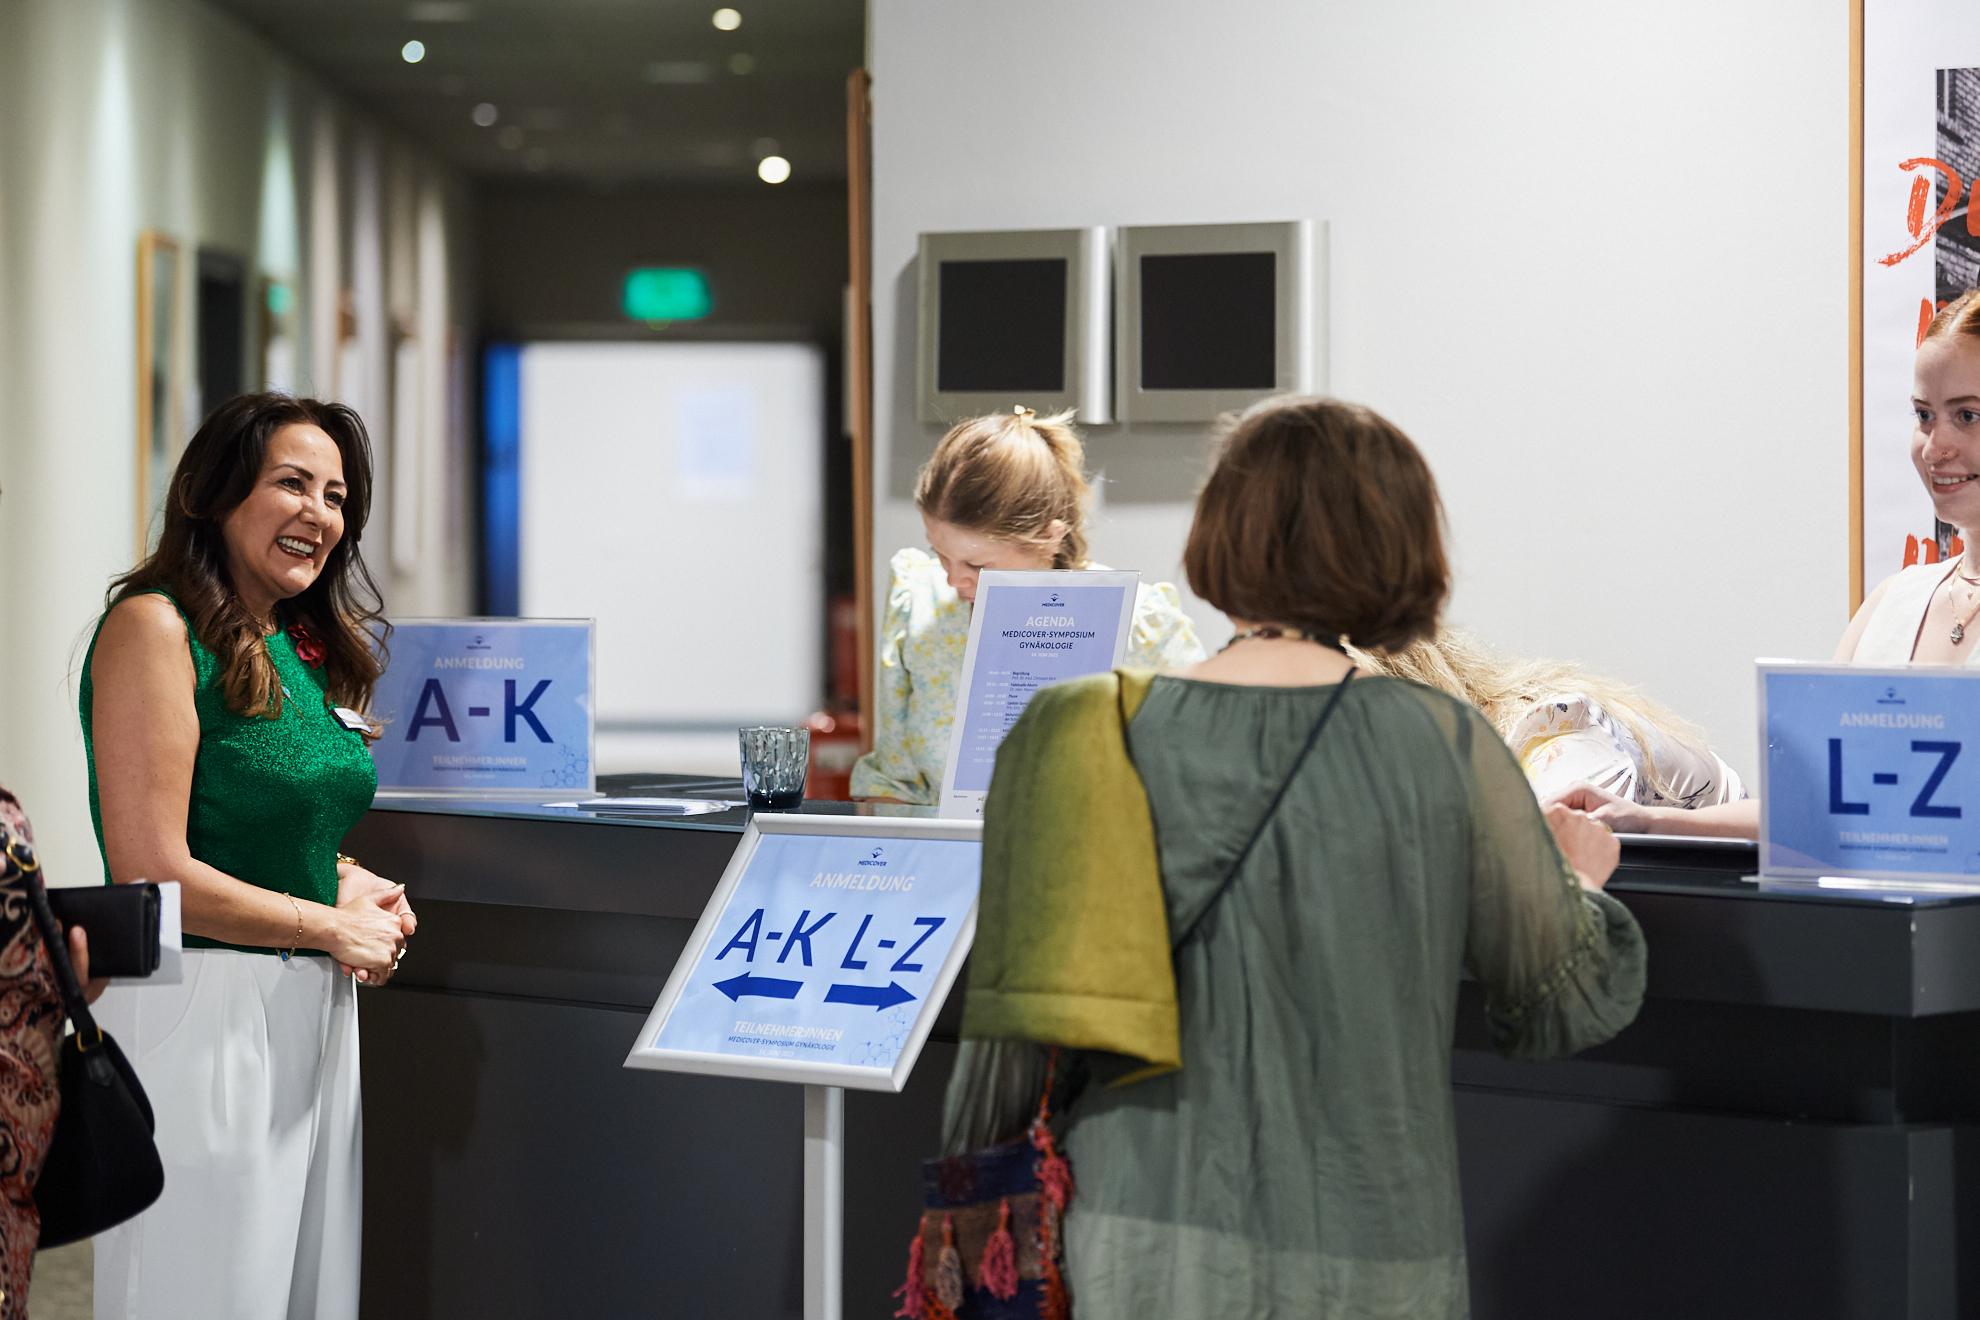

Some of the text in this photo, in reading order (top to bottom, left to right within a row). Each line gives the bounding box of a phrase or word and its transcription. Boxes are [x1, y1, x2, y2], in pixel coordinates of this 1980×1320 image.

[1025, 616, 1075, 627] AGENDA
[1001, 630, 1095, 639] MEDICOVER-SYMPOSIUM
[1019, 641, 1073, 650] GYNÄKOLOGIE
[434, 656, 524, 670] ANMELDUNG
[1839, 712, 1945, 729] ANMELDUNG
[809, 872, 916, 892] ANMELDUNG
[714, 908, 946, 973] A-K L-Z
